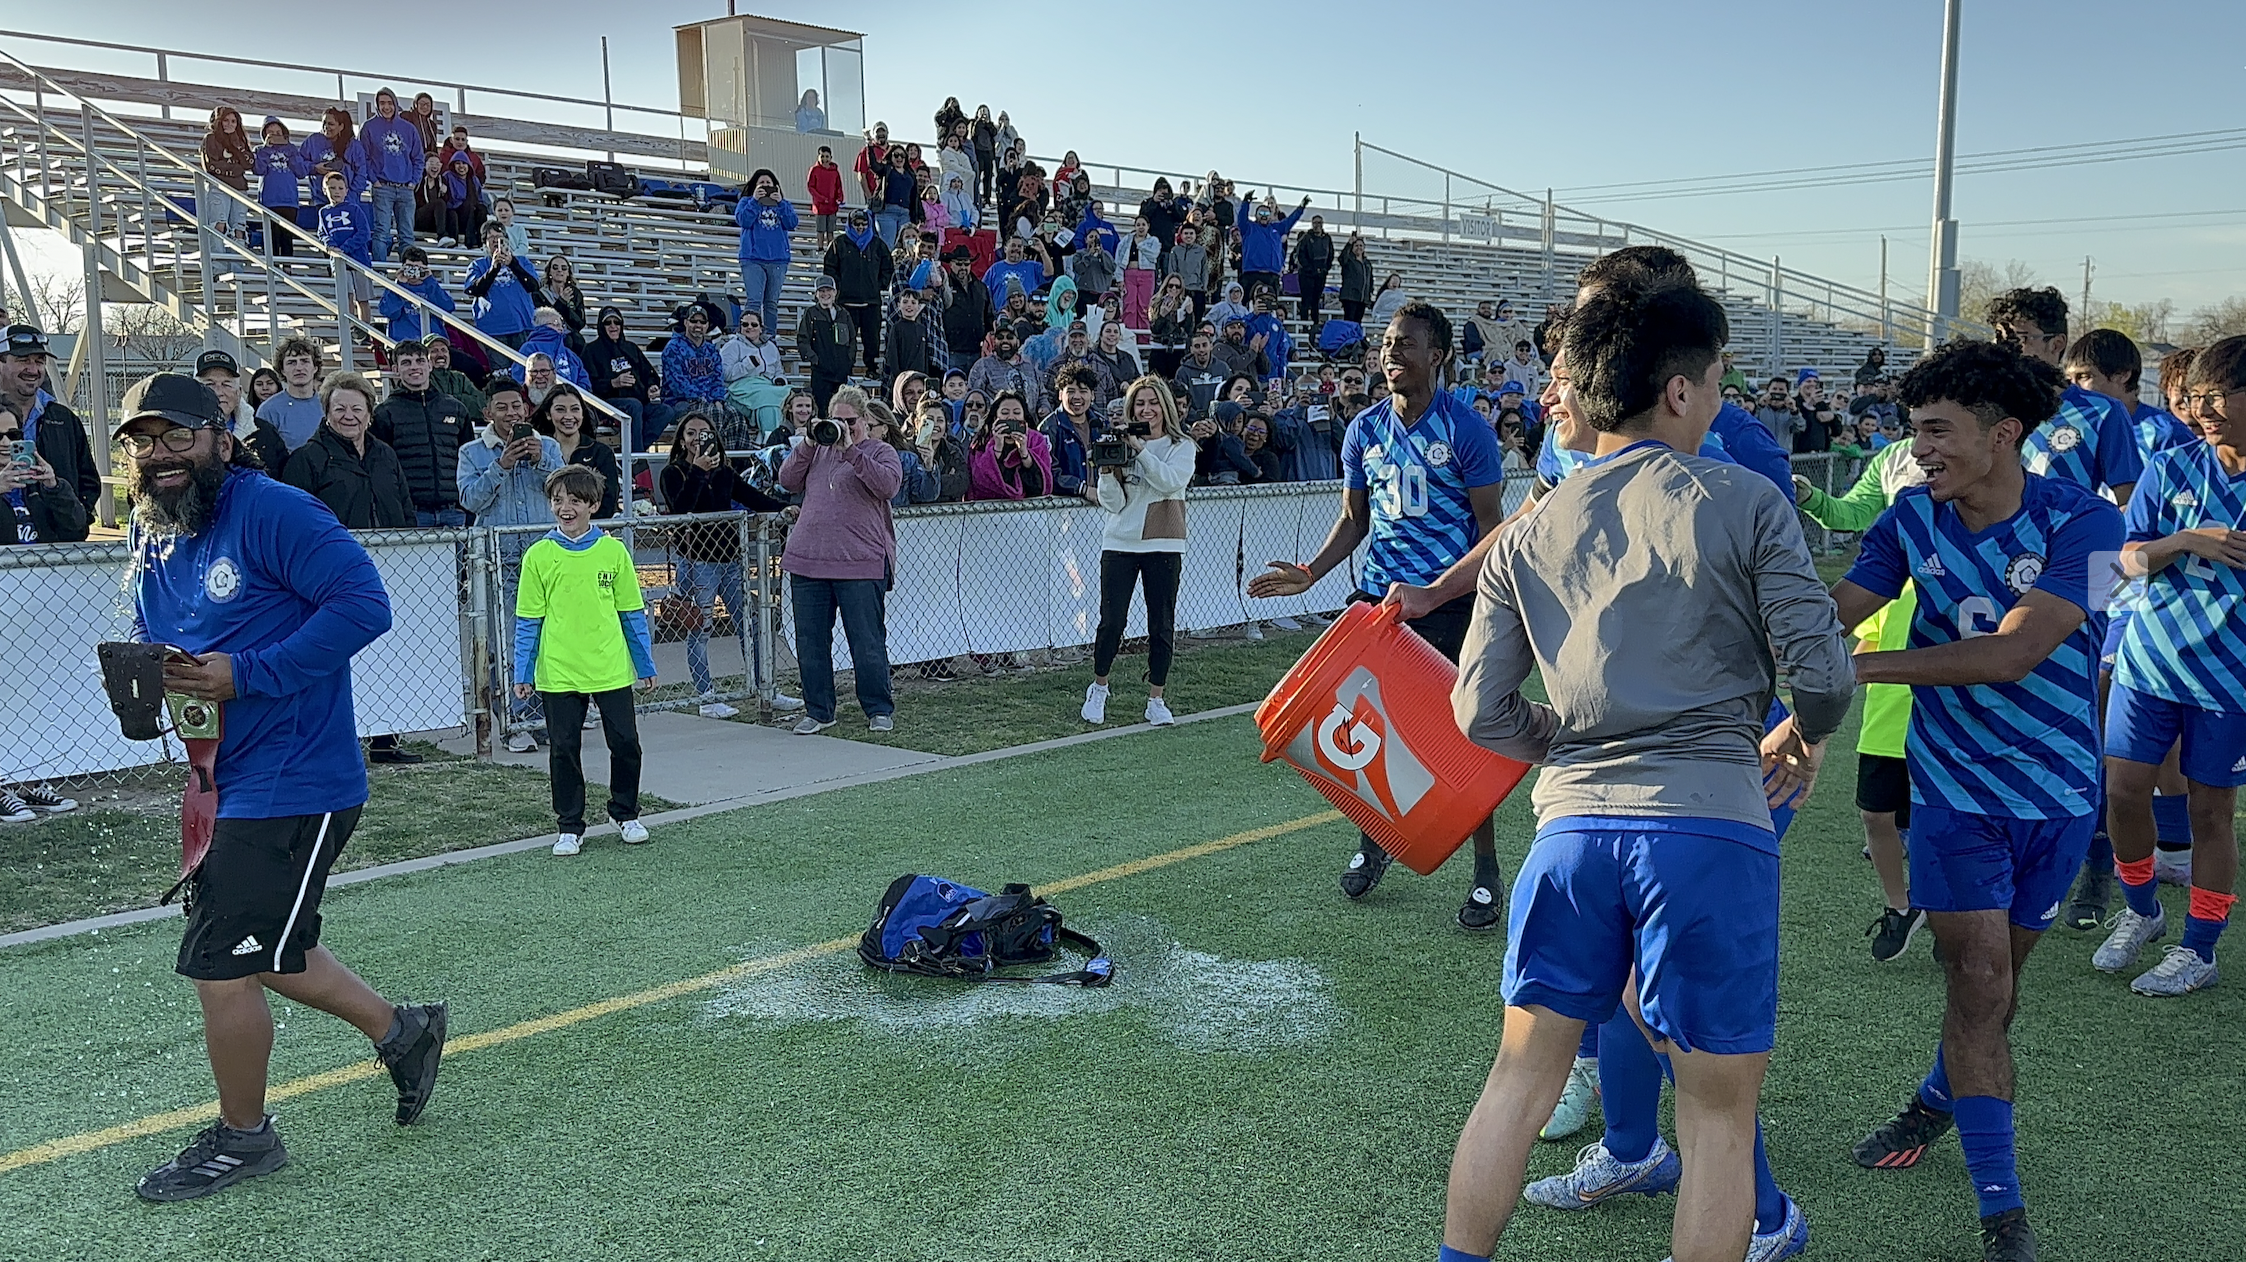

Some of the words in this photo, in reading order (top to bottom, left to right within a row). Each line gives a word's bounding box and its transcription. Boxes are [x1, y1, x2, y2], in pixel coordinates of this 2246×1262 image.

[1462, 219, 1491, 236] VISITOR
[1378, 465, 1428, 517] 30
[1917, 566, 1946, 576] adidas
[1316, 702, 1382, 771] G
[231, 944, 263, 955] adidas
